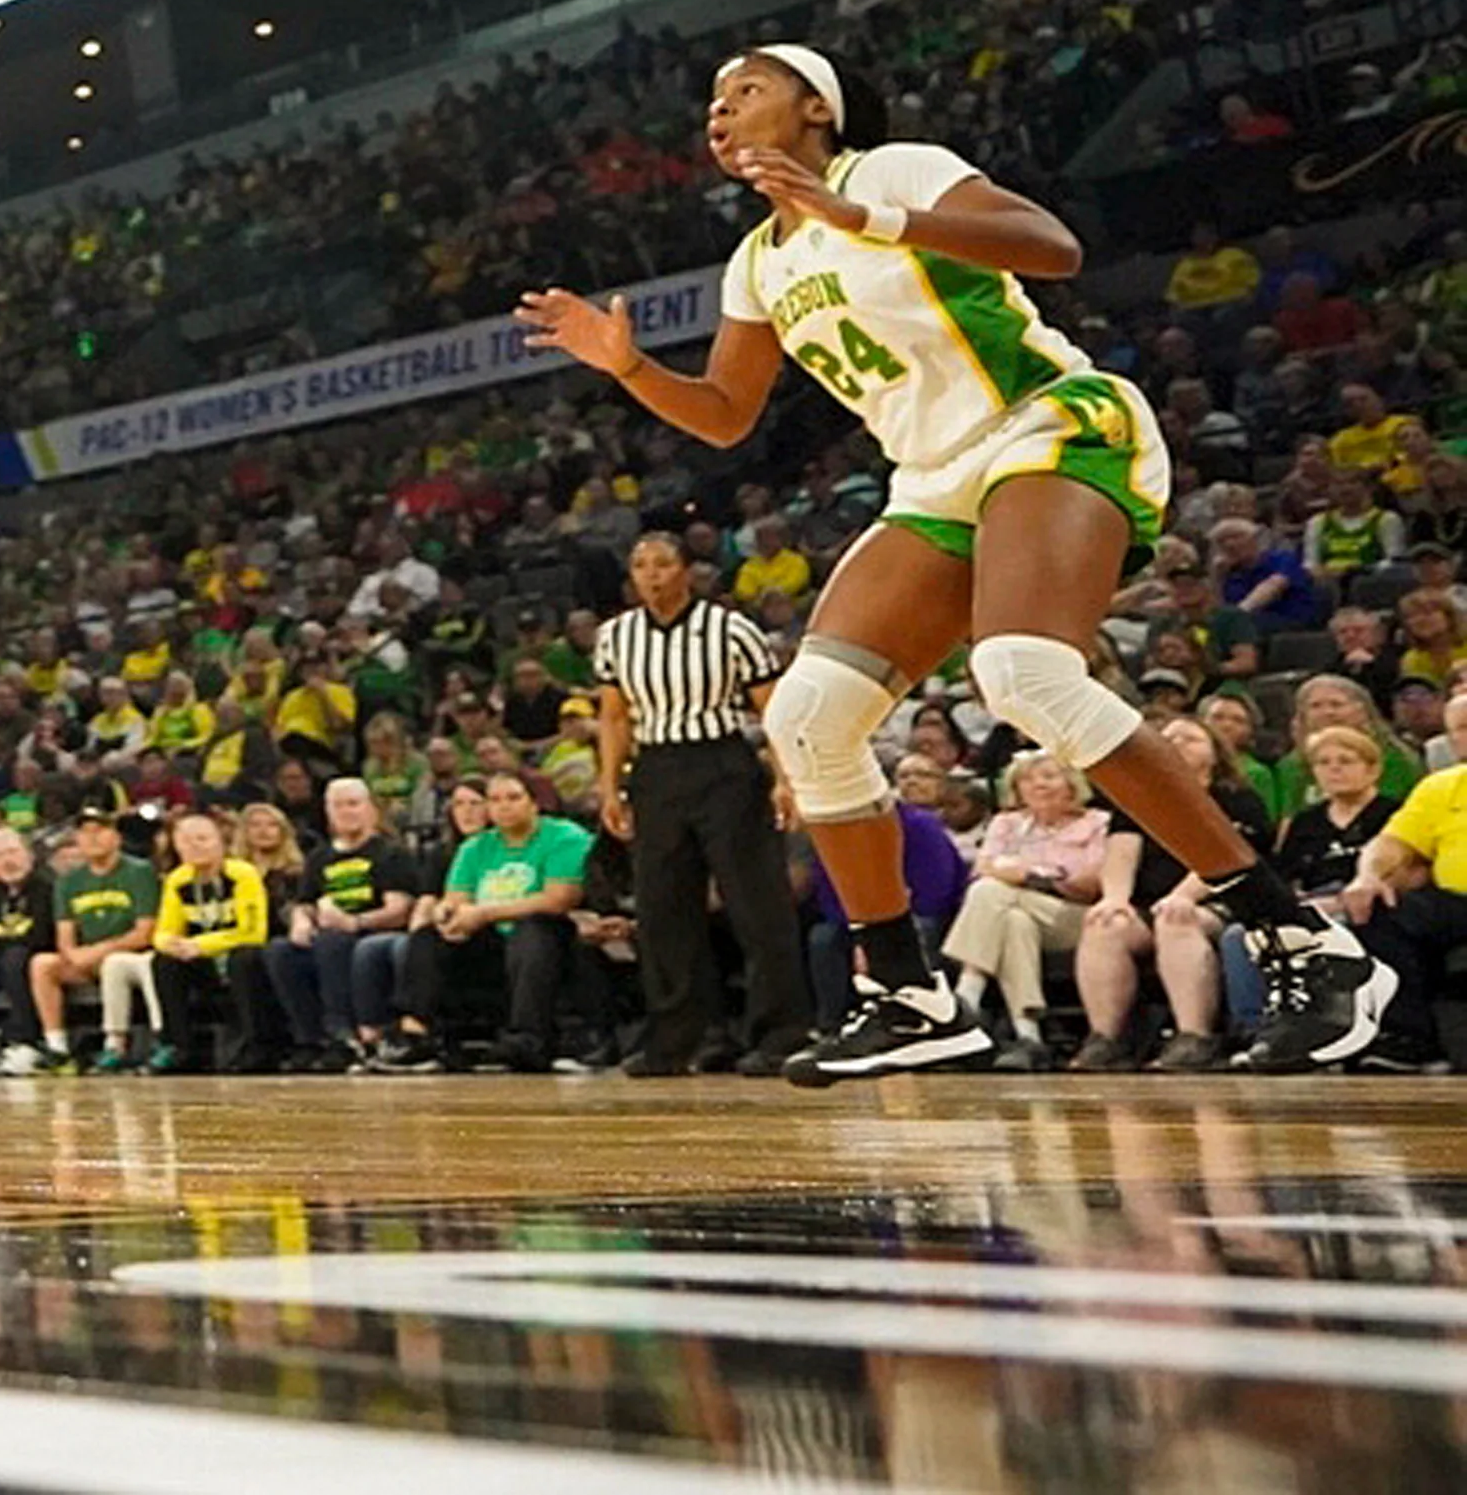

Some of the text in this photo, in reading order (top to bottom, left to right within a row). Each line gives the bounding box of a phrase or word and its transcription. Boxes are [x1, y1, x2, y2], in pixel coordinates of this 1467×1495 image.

[79, 407, 171, 455] PAC-12
[176, 378, 298, 433] WOMEN'S
[307, 338, 478, 408] BASKETBALL
[797, 317, 908, 400] 24
